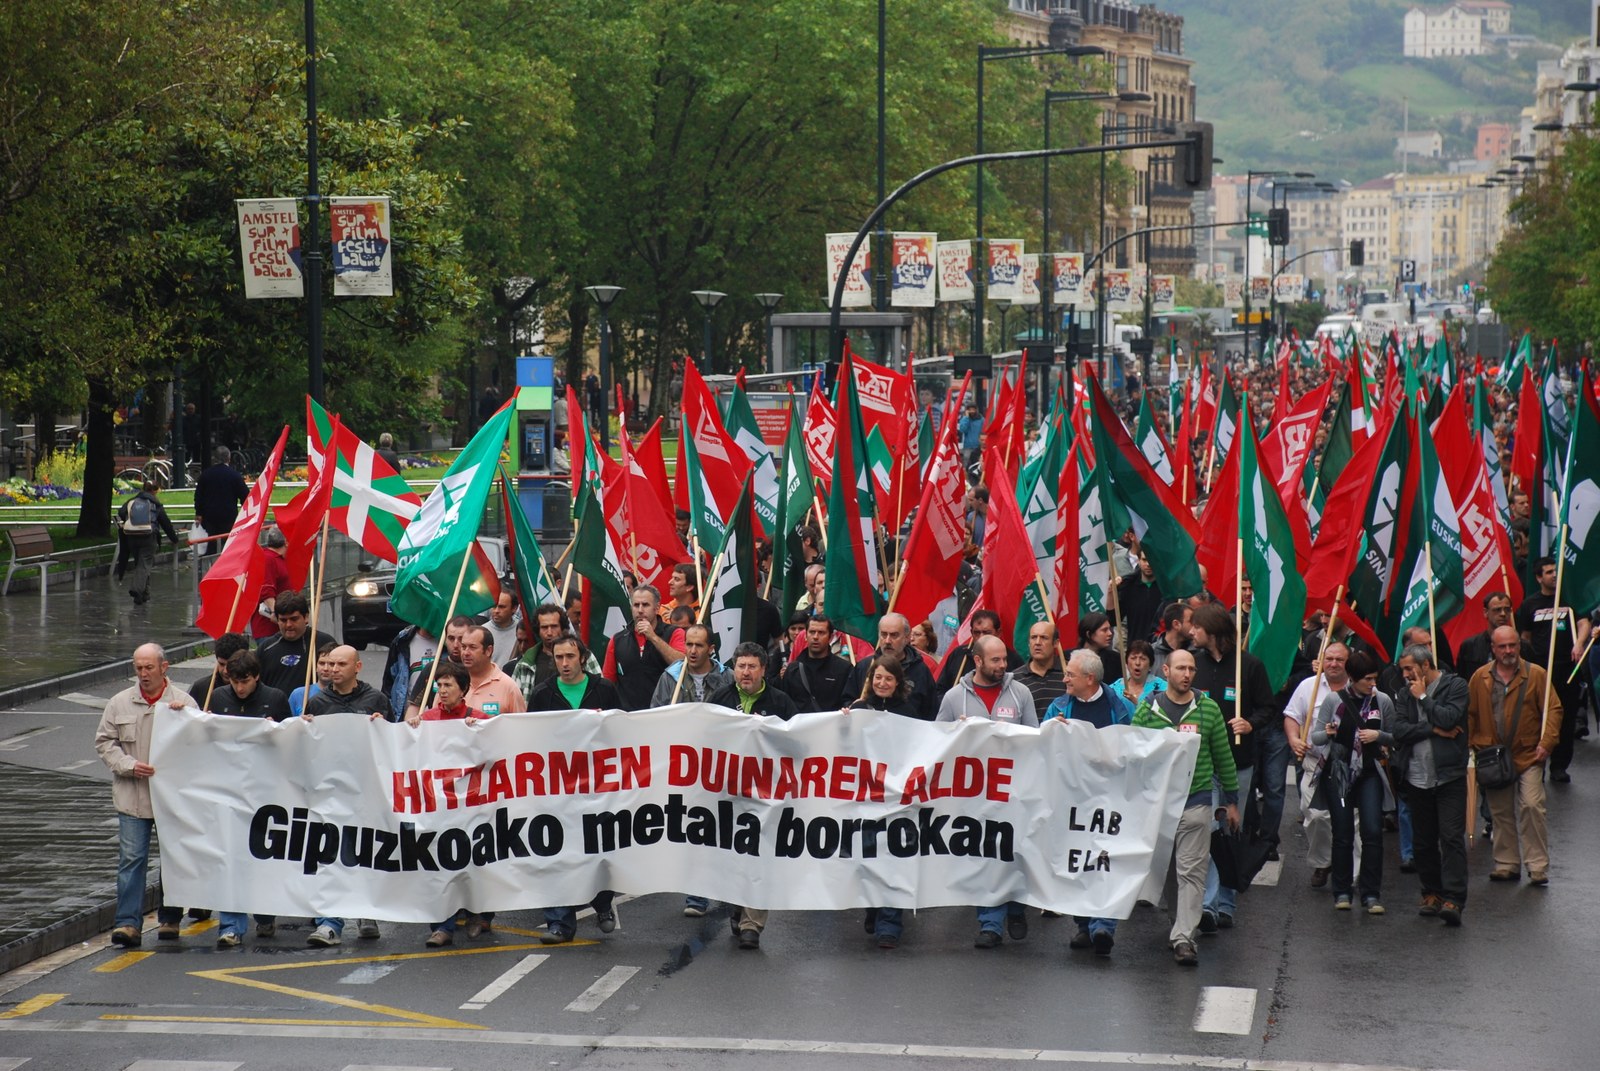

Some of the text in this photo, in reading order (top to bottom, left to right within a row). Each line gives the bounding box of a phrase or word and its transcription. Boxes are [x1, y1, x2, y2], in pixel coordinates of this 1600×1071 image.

[242, 212, 295, 225] AMSTEL
[393, 745, 1014, 814] HITZARMEN DUINAREN ALDE
[248, 794, 1014, 874] Gipuzkoako metala borrokan
[1069, 806, 1122, 836] LAB
[1068, 849, 1110, 873] ELA
